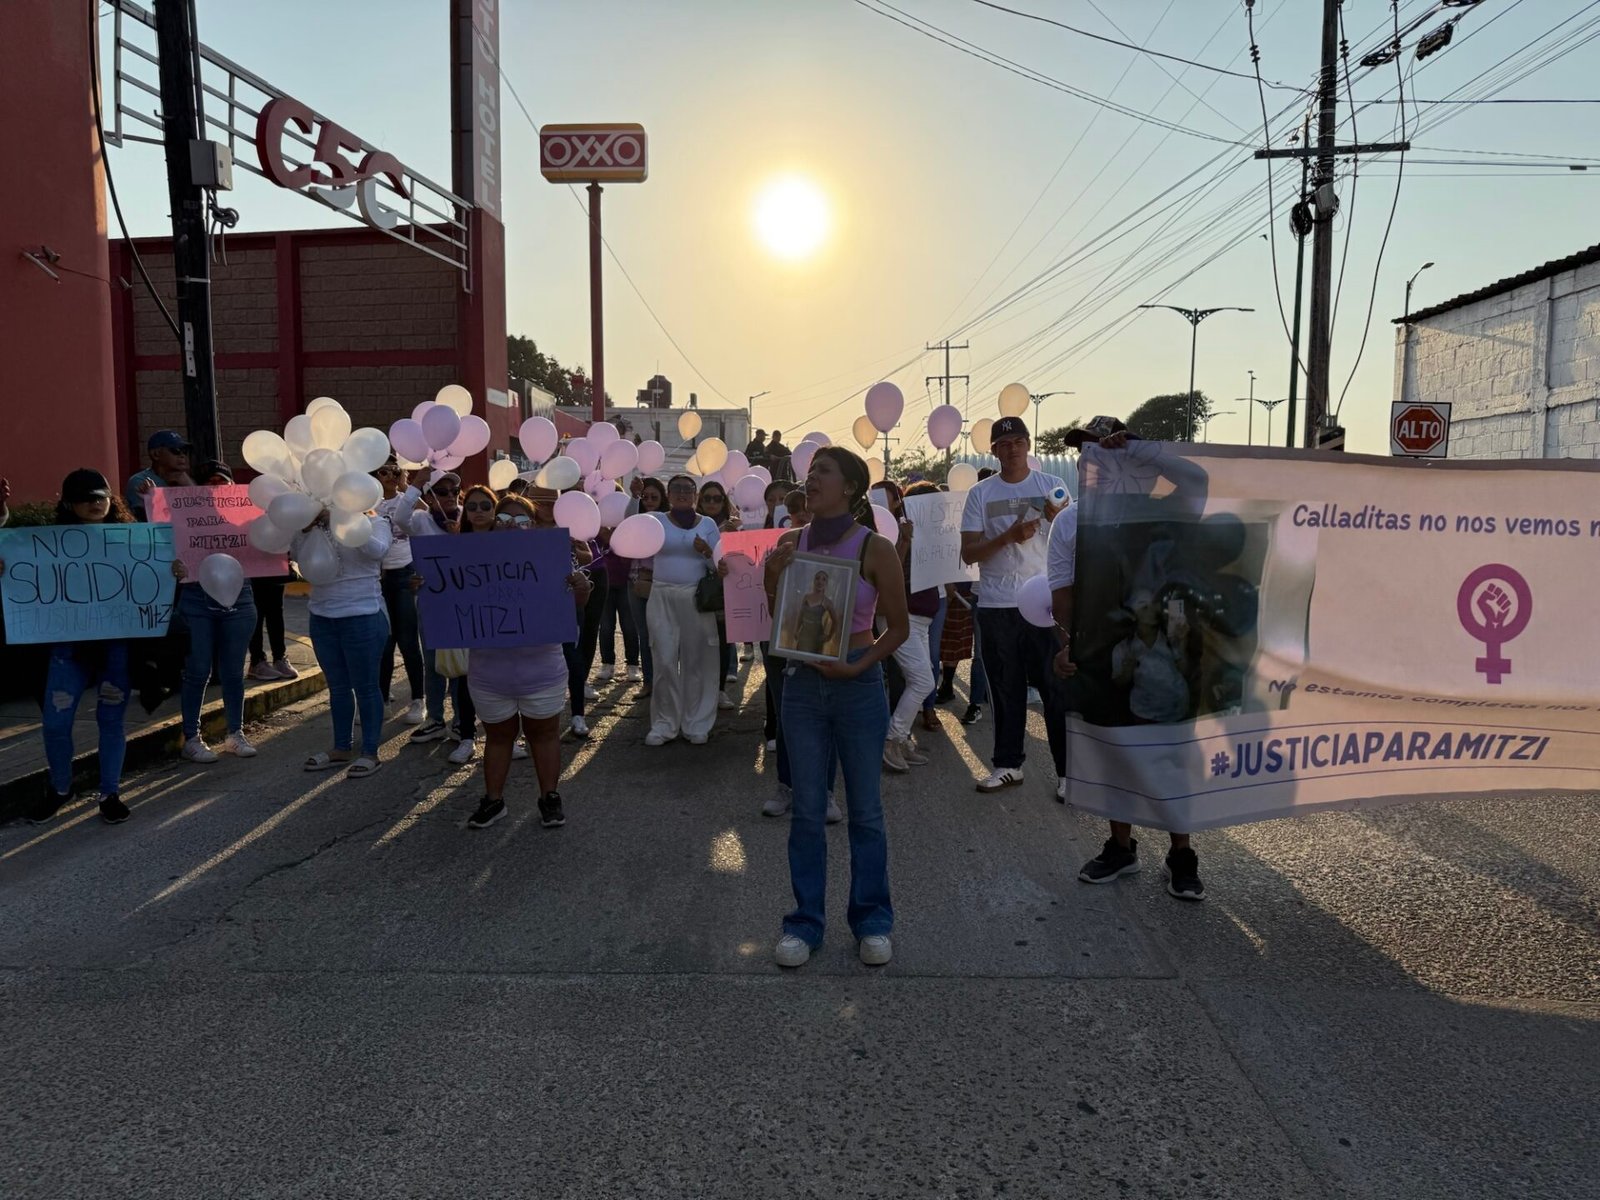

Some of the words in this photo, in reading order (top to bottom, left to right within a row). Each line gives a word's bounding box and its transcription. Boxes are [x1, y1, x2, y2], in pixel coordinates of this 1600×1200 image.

[478, 74, 497, 210] HOTEL
[543, 134, 641, 168] OXXO
[1398, 420, 1440, 439] ALTO
[171, 496, 253, 509] JUSTICIA
[186, 515, 229, 528] PARA
[1292, 504, 1411, 531] Calladitas
[1419, 514, 1447, 532] no
[1455, 514, 1497, 534] nos
[1505, 517, 1581, 537] vemos
[32, 528, 90, 559] NO
[103, 526, 173, 563] FUE
[189, 534, 247, 550] MITZI
[8, 561, 160, 605] SUICIDIO
[424, 555, 538, 594] JUSTICIA
[487, 585, 525, 601] PARA
[454, 603, 524, 640] MITZI
[1268, 679, 1297, 693] No
[1304, 682, 1405, 701] estamos
[1411, 696, 1539, 709] completas
[1210, 731, 1551, 779] #JUSTICIAPARAMITZI
